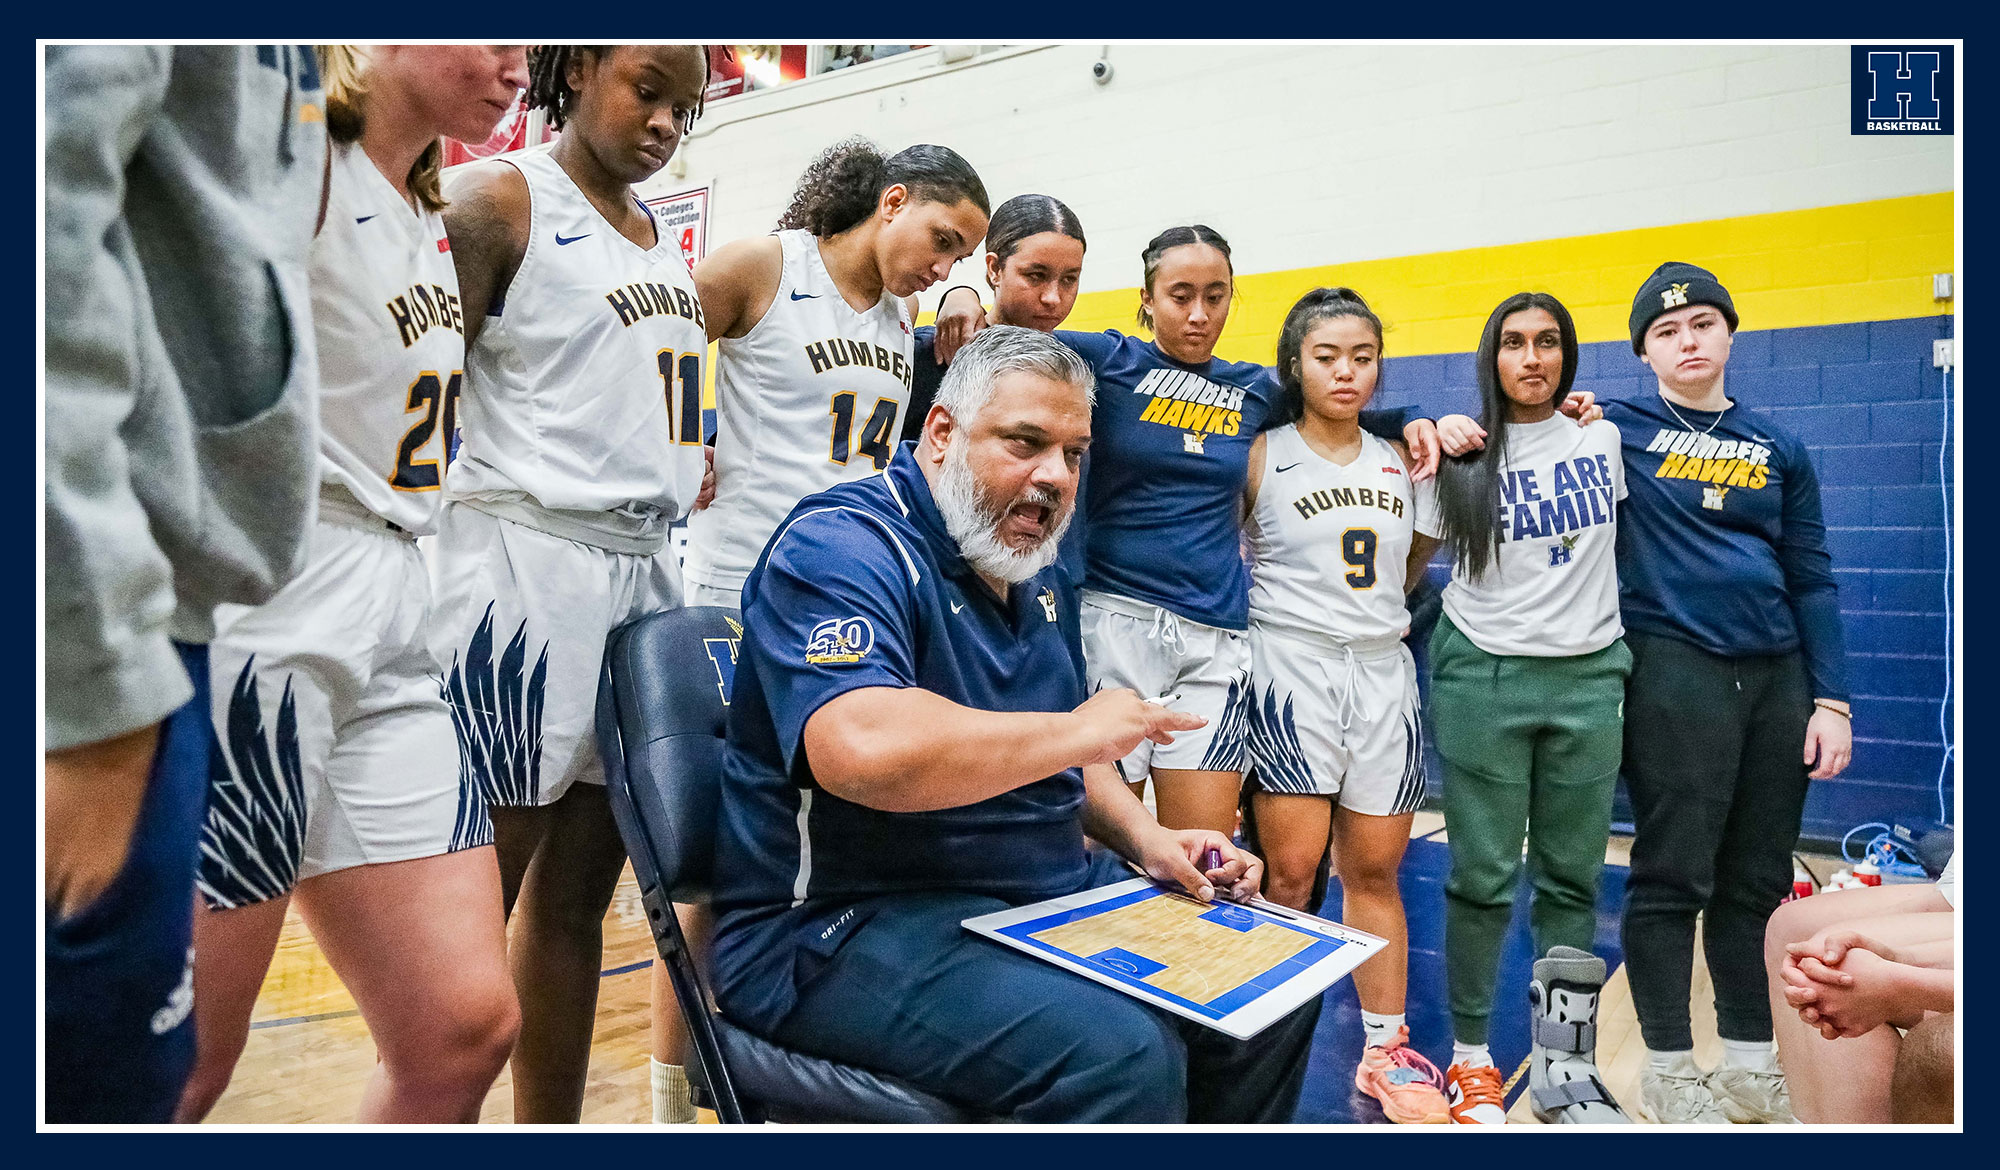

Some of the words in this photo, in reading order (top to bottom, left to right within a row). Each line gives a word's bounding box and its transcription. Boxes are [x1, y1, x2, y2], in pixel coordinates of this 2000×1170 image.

[660, 201, 694, 216] Colleges
[605, 282, 708, 331] HUMBE
[805, 338, 912, 392] HUMBER
[656, 347, 702, 446] 11
[1133, 368, 1247, 412] HUMBER
[829, 390, 899, 472] 14
[1139, 396, 1242, 437] HAWKS
[1646, 428, 1772, 466] HUMBER
[1554, 453, 1612, 497] ARE
[1655, 452, 1770, 490] HAWKS
[1292, 487, 1405, 521] HUMBER
[1498, 486, 1614, 544] FAMILY
[1340, 526, 1379, 591] 9
[821, 909, 854, 939] DRI-FIT
